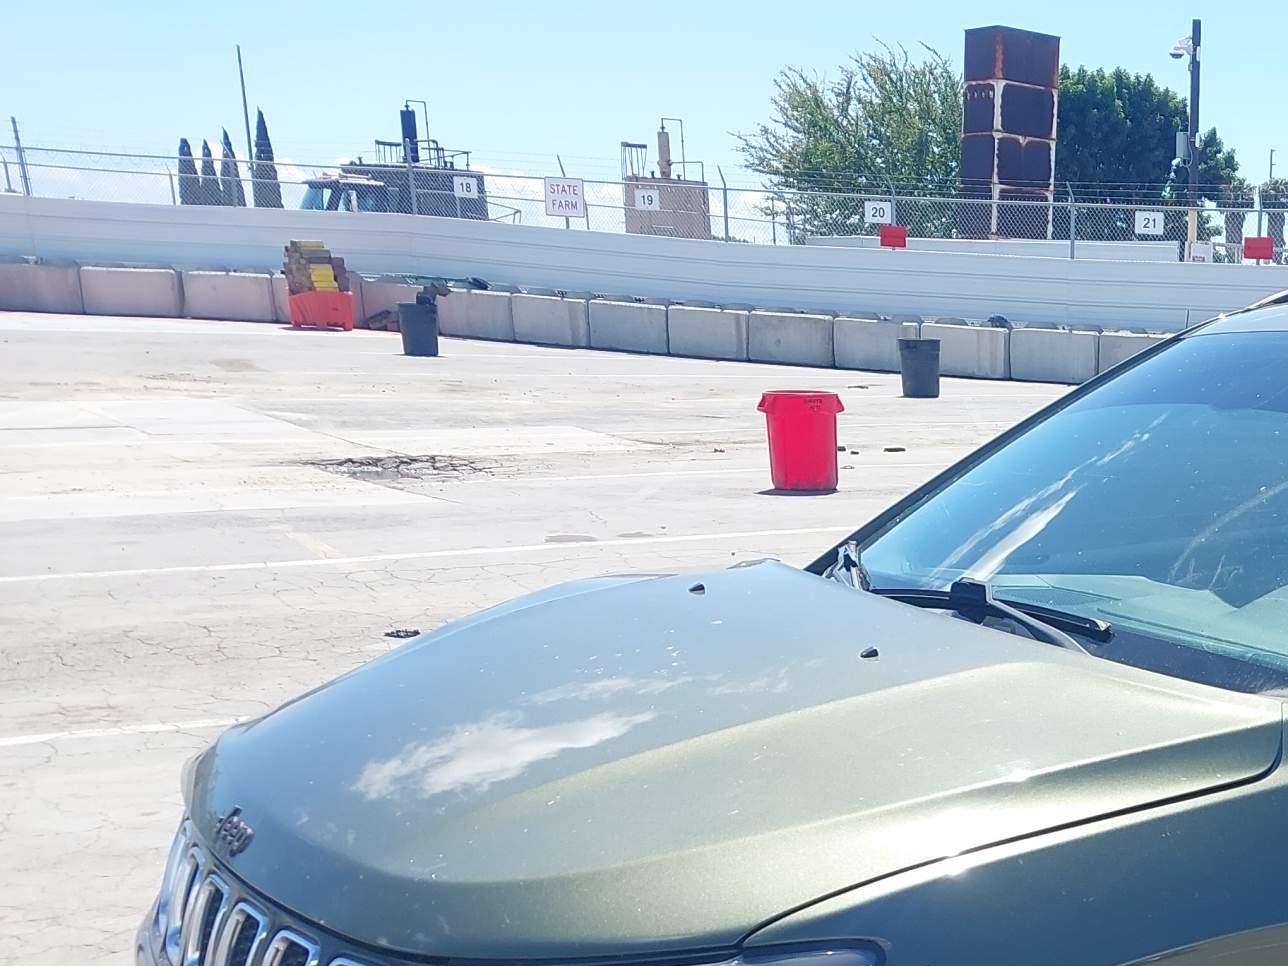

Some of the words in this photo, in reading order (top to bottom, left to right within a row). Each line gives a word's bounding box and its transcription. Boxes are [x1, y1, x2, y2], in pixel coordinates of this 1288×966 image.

[458, 182, 468, 193] 18
[549, 183, 578, 196] STATE
[551, 200, 578, 211] FARM
[640, 195, 653, 206] 19
[871, 206, 885, 219] 20
[1143, 216, 1158, 229] 21
